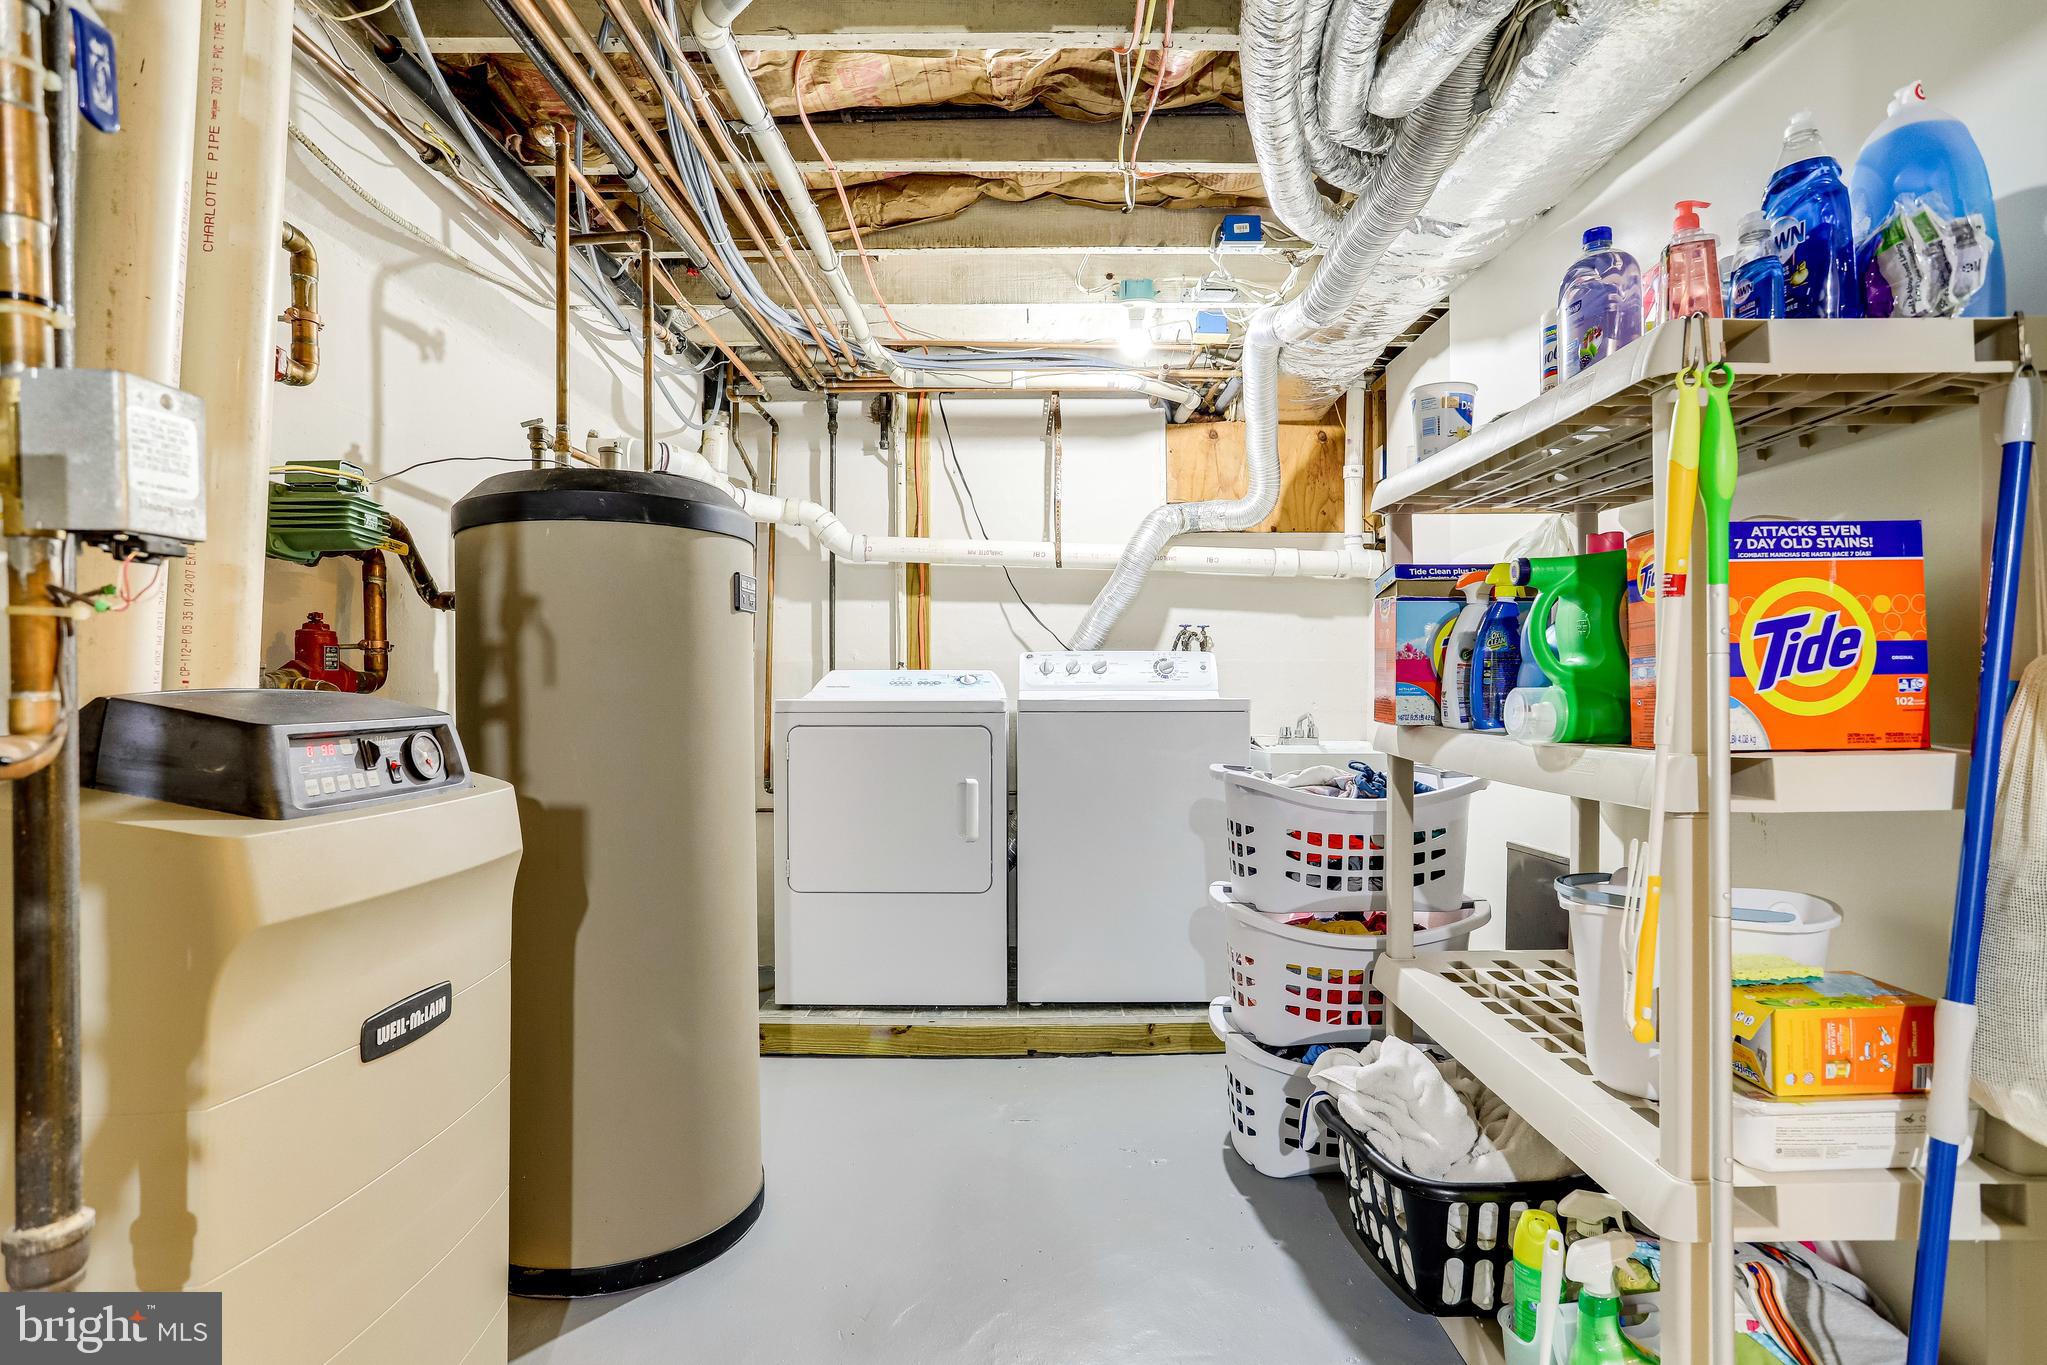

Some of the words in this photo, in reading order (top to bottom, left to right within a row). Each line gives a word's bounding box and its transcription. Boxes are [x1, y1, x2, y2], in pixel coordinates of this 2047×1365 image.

[214, 22, 226, 41] TYPE
[213, 45, 225, 59] PVC
[207, 125, 220, 161] PIPE
[203, 170, 217, 253] CHARLOTTE
[1774, 219, 1806, 251] WN
[1736, 282, 1753, 299] AWN
[1750, 525, 1818, 537] ATTACKS
[1820, 524, 1861, 536] EVEN
[1733, 538, 1743, 550] 7
[1746, 538, 1776, 550] DAY
[1780, 537, 1813, 549] OLD
[1816, 536, 1874, 549] STAINS!
[1408, 567, 1427, 576] Tide
[1428, 567, 1452, 576] Clean
[1453, 567, 1469, 578] plus
[184, 569, 196, 607] 01/24/07
[1751, 609, 1863, 694] Tide
[1895, 696, 1914, 706] 102
[318, 743, 335, 757] 96
